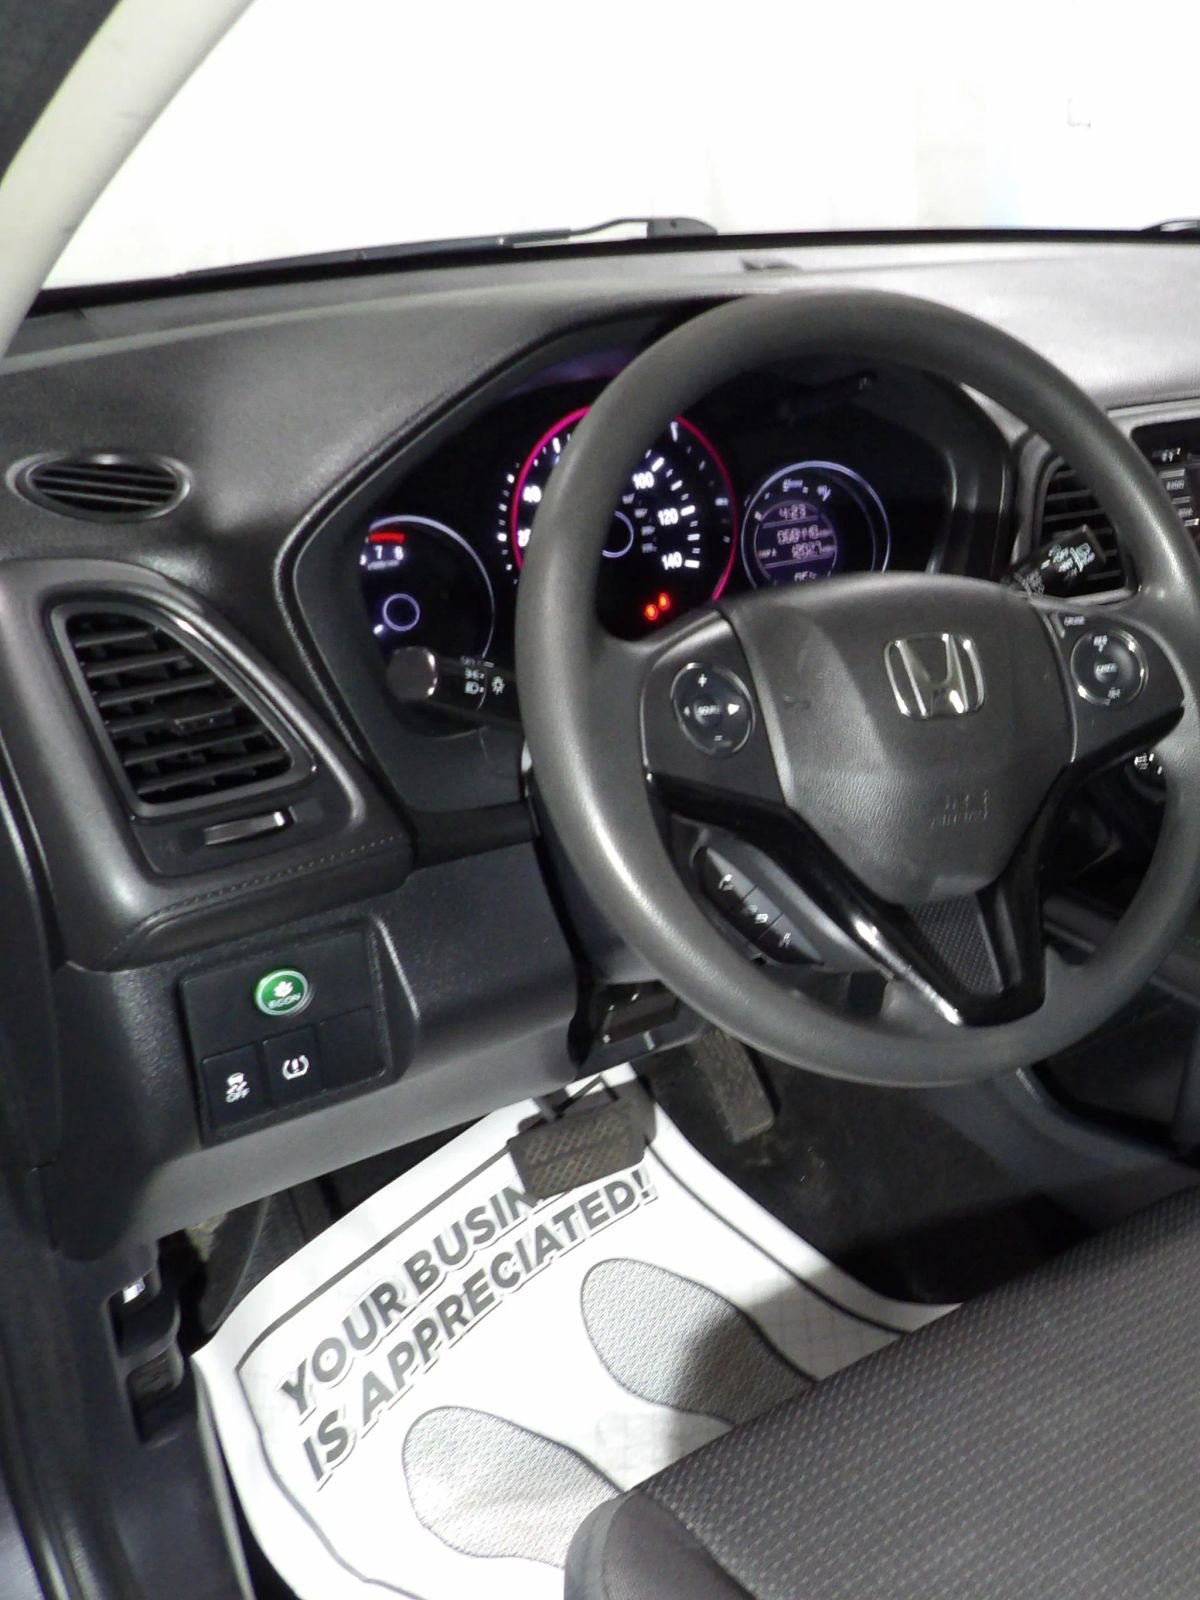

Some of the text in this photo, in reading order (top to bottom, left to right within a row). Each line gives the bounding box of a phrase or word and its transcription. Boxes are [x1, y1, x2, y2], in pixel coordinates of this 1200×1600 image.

[632, 471, 655, 490] 100
[657, 507, 679, 526] 120
[661, 551, 683, 570] 140
[281, 1185, 538, 1416] YOUR BUSIN
[303, 1168, 652, 1482] IS APPRECIATED!
